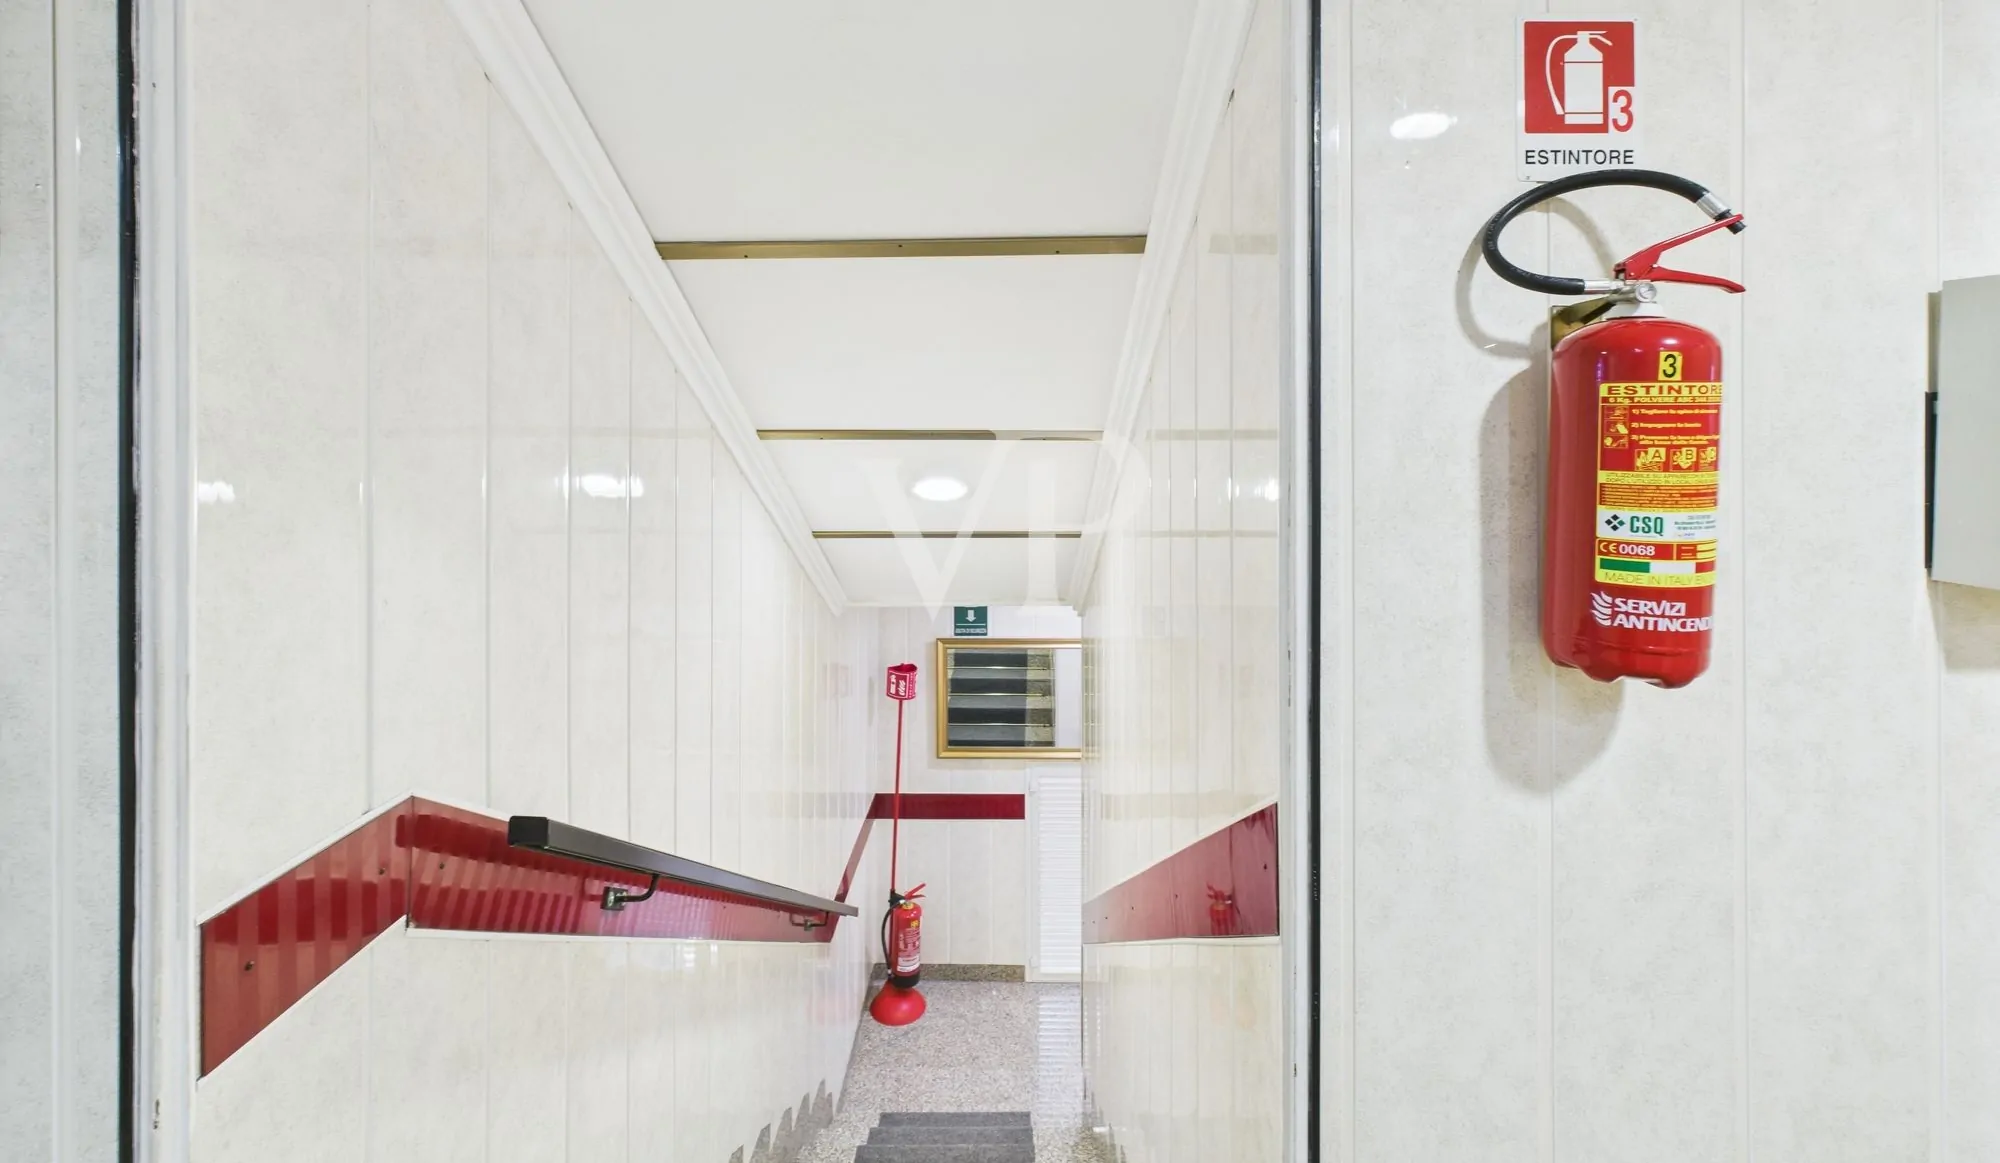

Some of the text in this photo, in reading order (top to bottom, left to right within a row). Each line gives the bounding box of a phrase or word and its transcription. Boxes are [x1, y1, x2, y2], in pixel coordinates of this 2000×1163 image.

[1611, 89, 1634, 132] 3
[1524, 150, 1634, 165] ESTINTORE
[1662, 354, 1677, 378] 3
[1652, 449, 1662, 460] A
[1685, 449, 1694, 460] B
[1630, 516, 1664, 536] CSQ
[1619, 544, 1656, 556] 0068
[1604, 572, 1644, 584] MADE
[1647, 574, 1661, 585] IN
[1664, 574, 1693, 585] ITALY
[1613, 598, 1686, 616] SERVIZI
